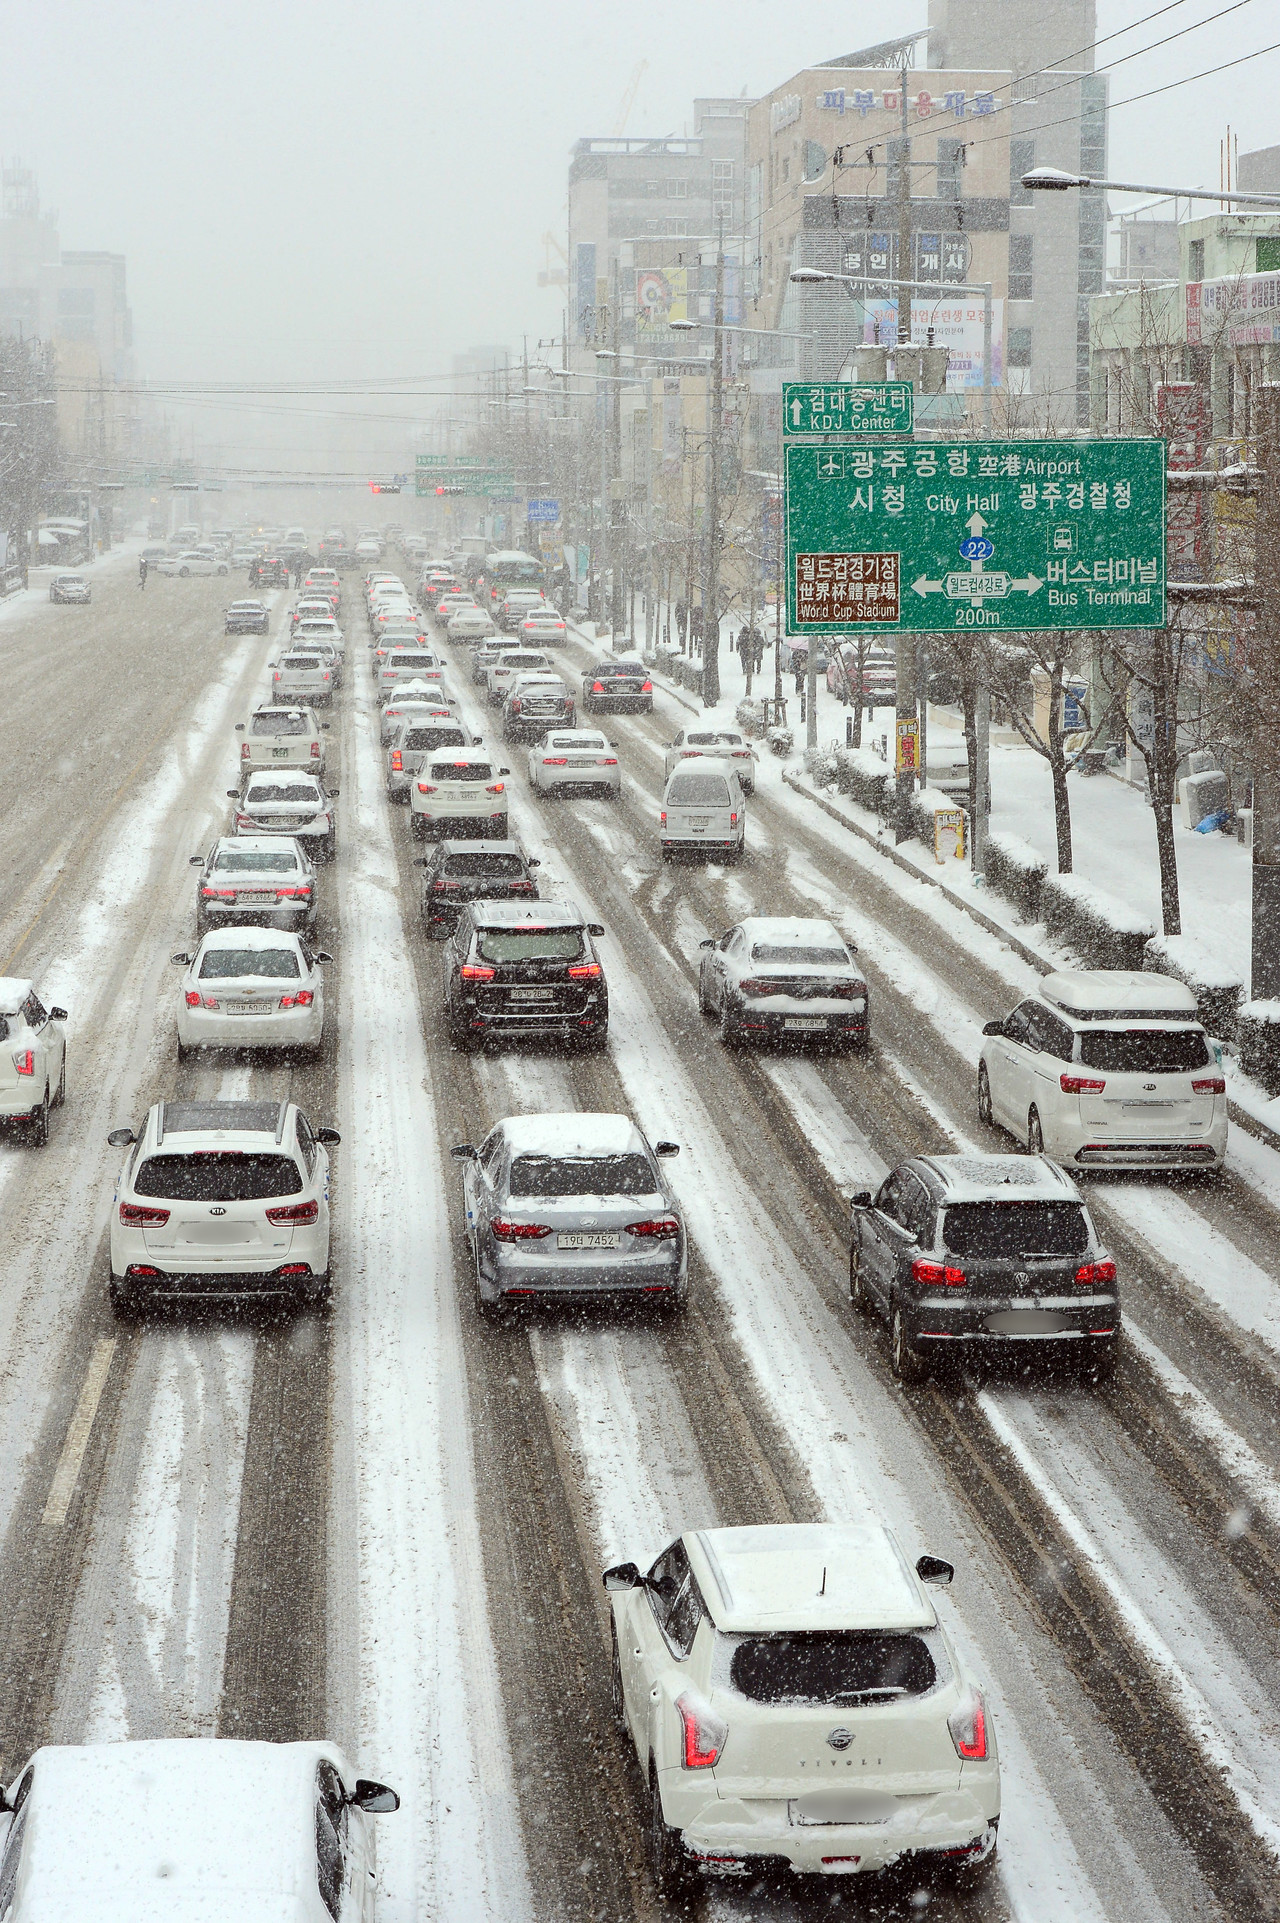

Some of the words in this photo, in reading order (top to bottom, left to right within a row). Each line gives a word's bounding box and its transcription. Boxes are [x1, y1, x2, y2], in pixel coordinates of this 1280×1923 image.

[844, 253, 964, 270] 공인개사
[809, 387, 906, 413] 김대중센터
[851, 414, 896, 429] Center
[850, 449, 971, 479] 광주공항
[978, 454, 1022, 478] 空港
[1025, 458, 1081, 478] Airport
[849, 484, 906, 513] 시청
[926, 494, 961, 514] City
[967, 493, 999, 512] Hall
[1018, 482, 1131, 510] 광주경찰청
[967, 541, 987, 558] 22
[800, 556, 896, 580] 월드컵경기장
[1047, 556, 1157, 585] 버스터미널
[799, 581, 897, 601] 世界杯體育場
[950, 577, 1004, 593] 월드컵4강로
[1049, 589, 1078, 606] Bus
[1086, 587, 1150, 605] Terminal
[801, 603, 829, 618] World
[833, 603, 853, 620] Cup
[857, 602, 895, 618] Stadium
[955, 608, 1000, 626] 200m
[210, 1207, 226, 1216] KIA
[588, 1235, 614, 1246] 7452
[799, 1757, 883, 1768] TIVOLI
